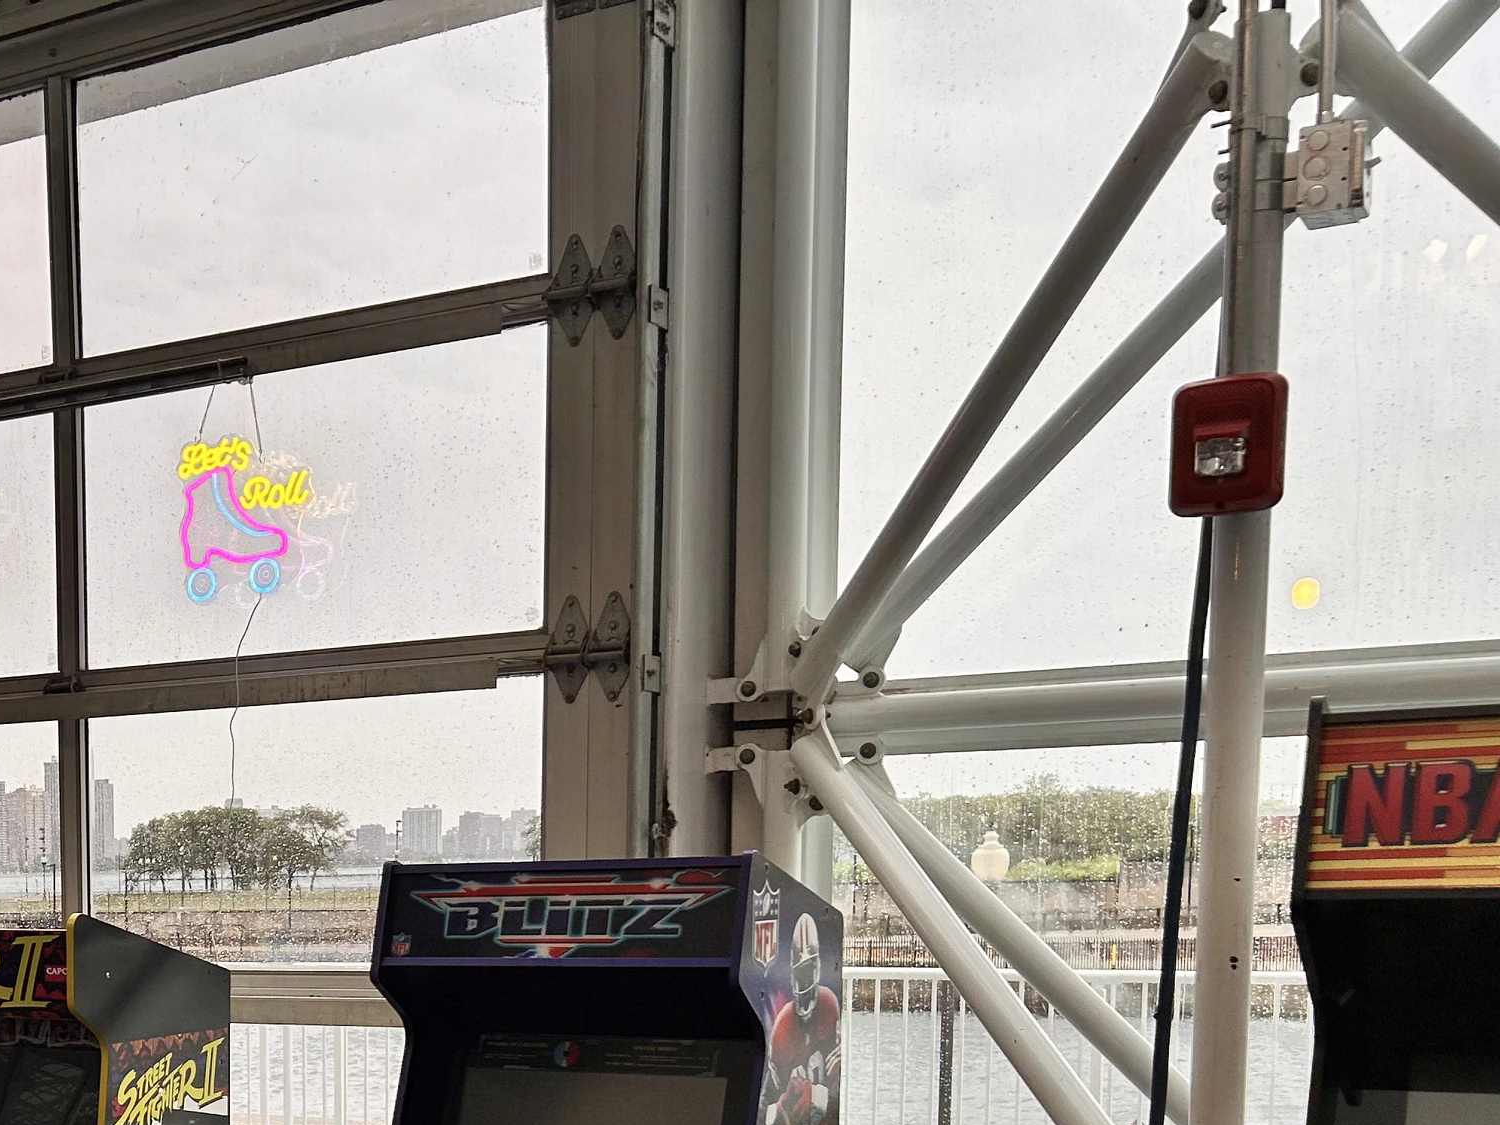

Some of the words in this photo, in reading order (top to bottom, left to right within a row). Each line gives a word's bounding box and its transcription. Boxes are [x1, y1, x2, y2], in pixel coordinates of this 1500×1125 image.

[178, 437, 252, 479] Let's
[239, 469, 309, 510] Roll
[444, 896, 690, 939] BLITZ
[754, 918, 778, 962] NFL
